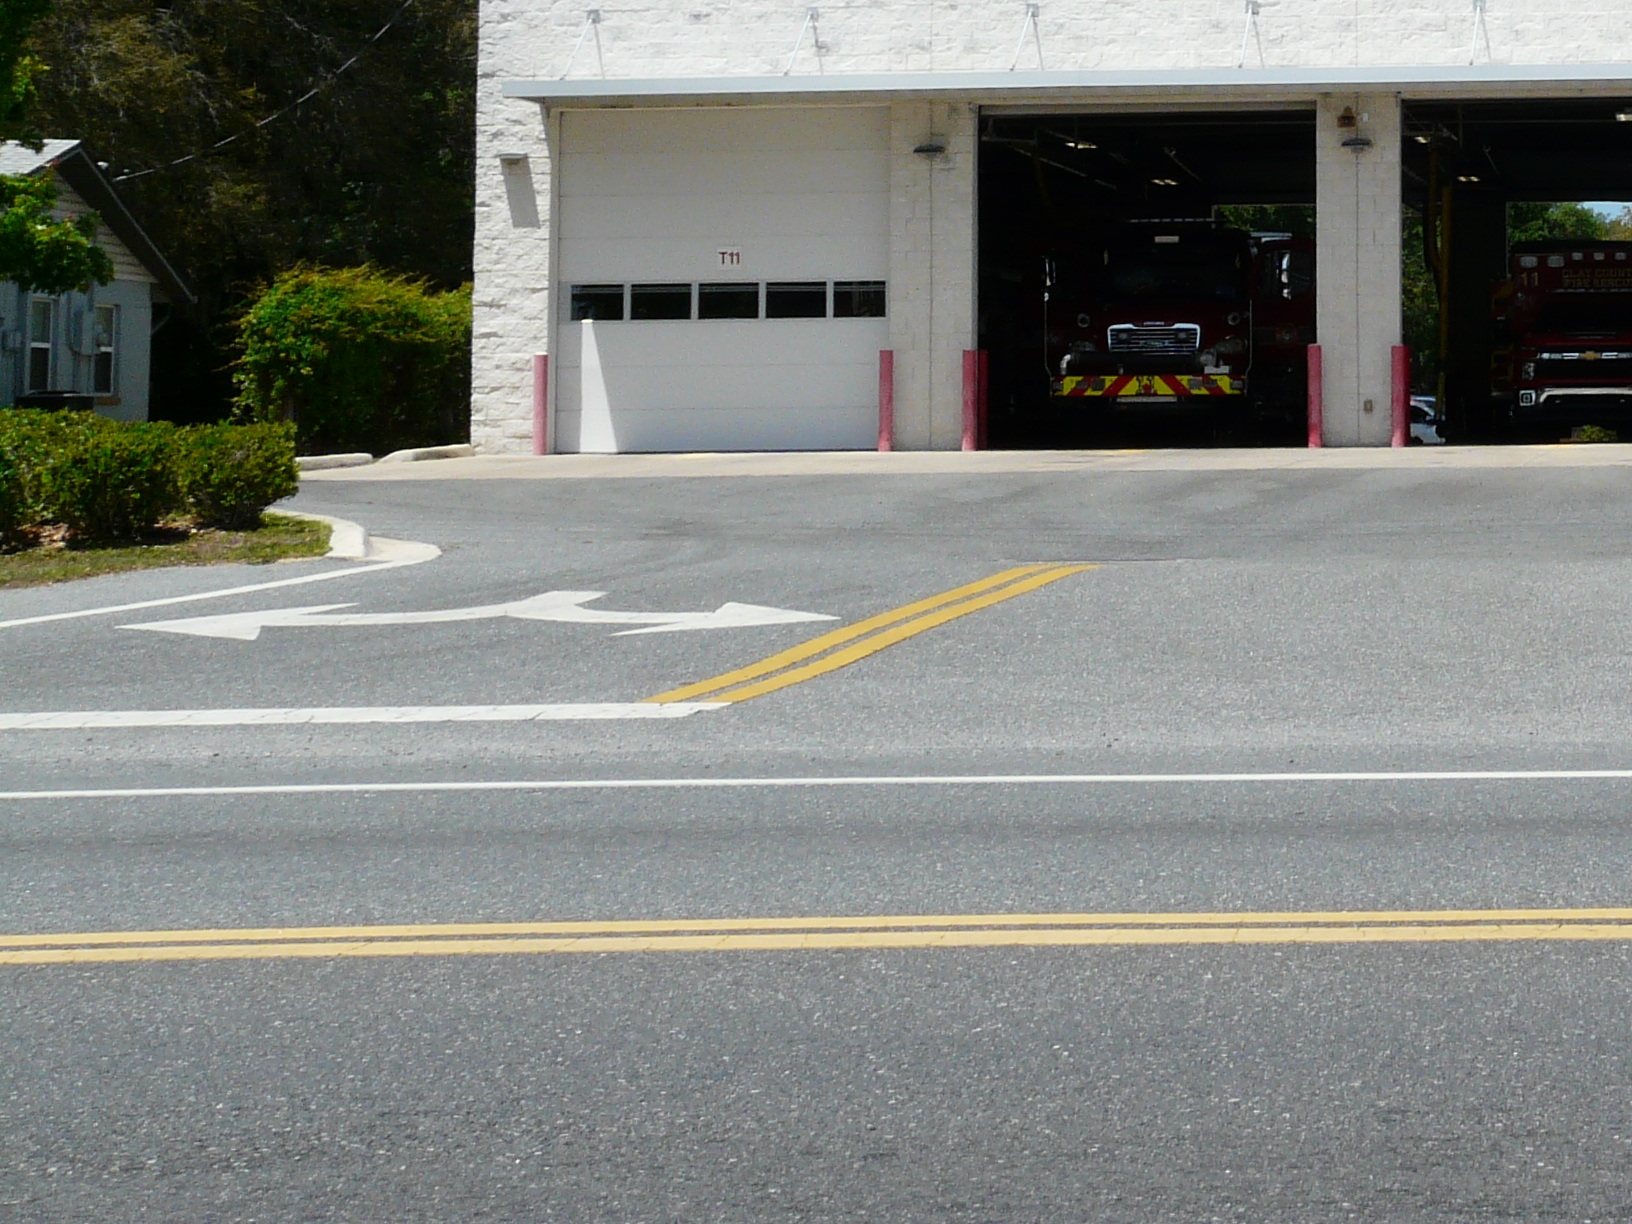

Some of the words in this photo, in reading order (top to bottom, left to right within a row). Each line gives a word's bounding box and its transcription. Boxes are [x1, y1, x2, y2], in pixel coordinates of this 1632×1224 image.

[718, 251, 740, 265] T11
[1520, 271, 1539, 287] 11
[1561, 268, 1591, 278] CLAY
